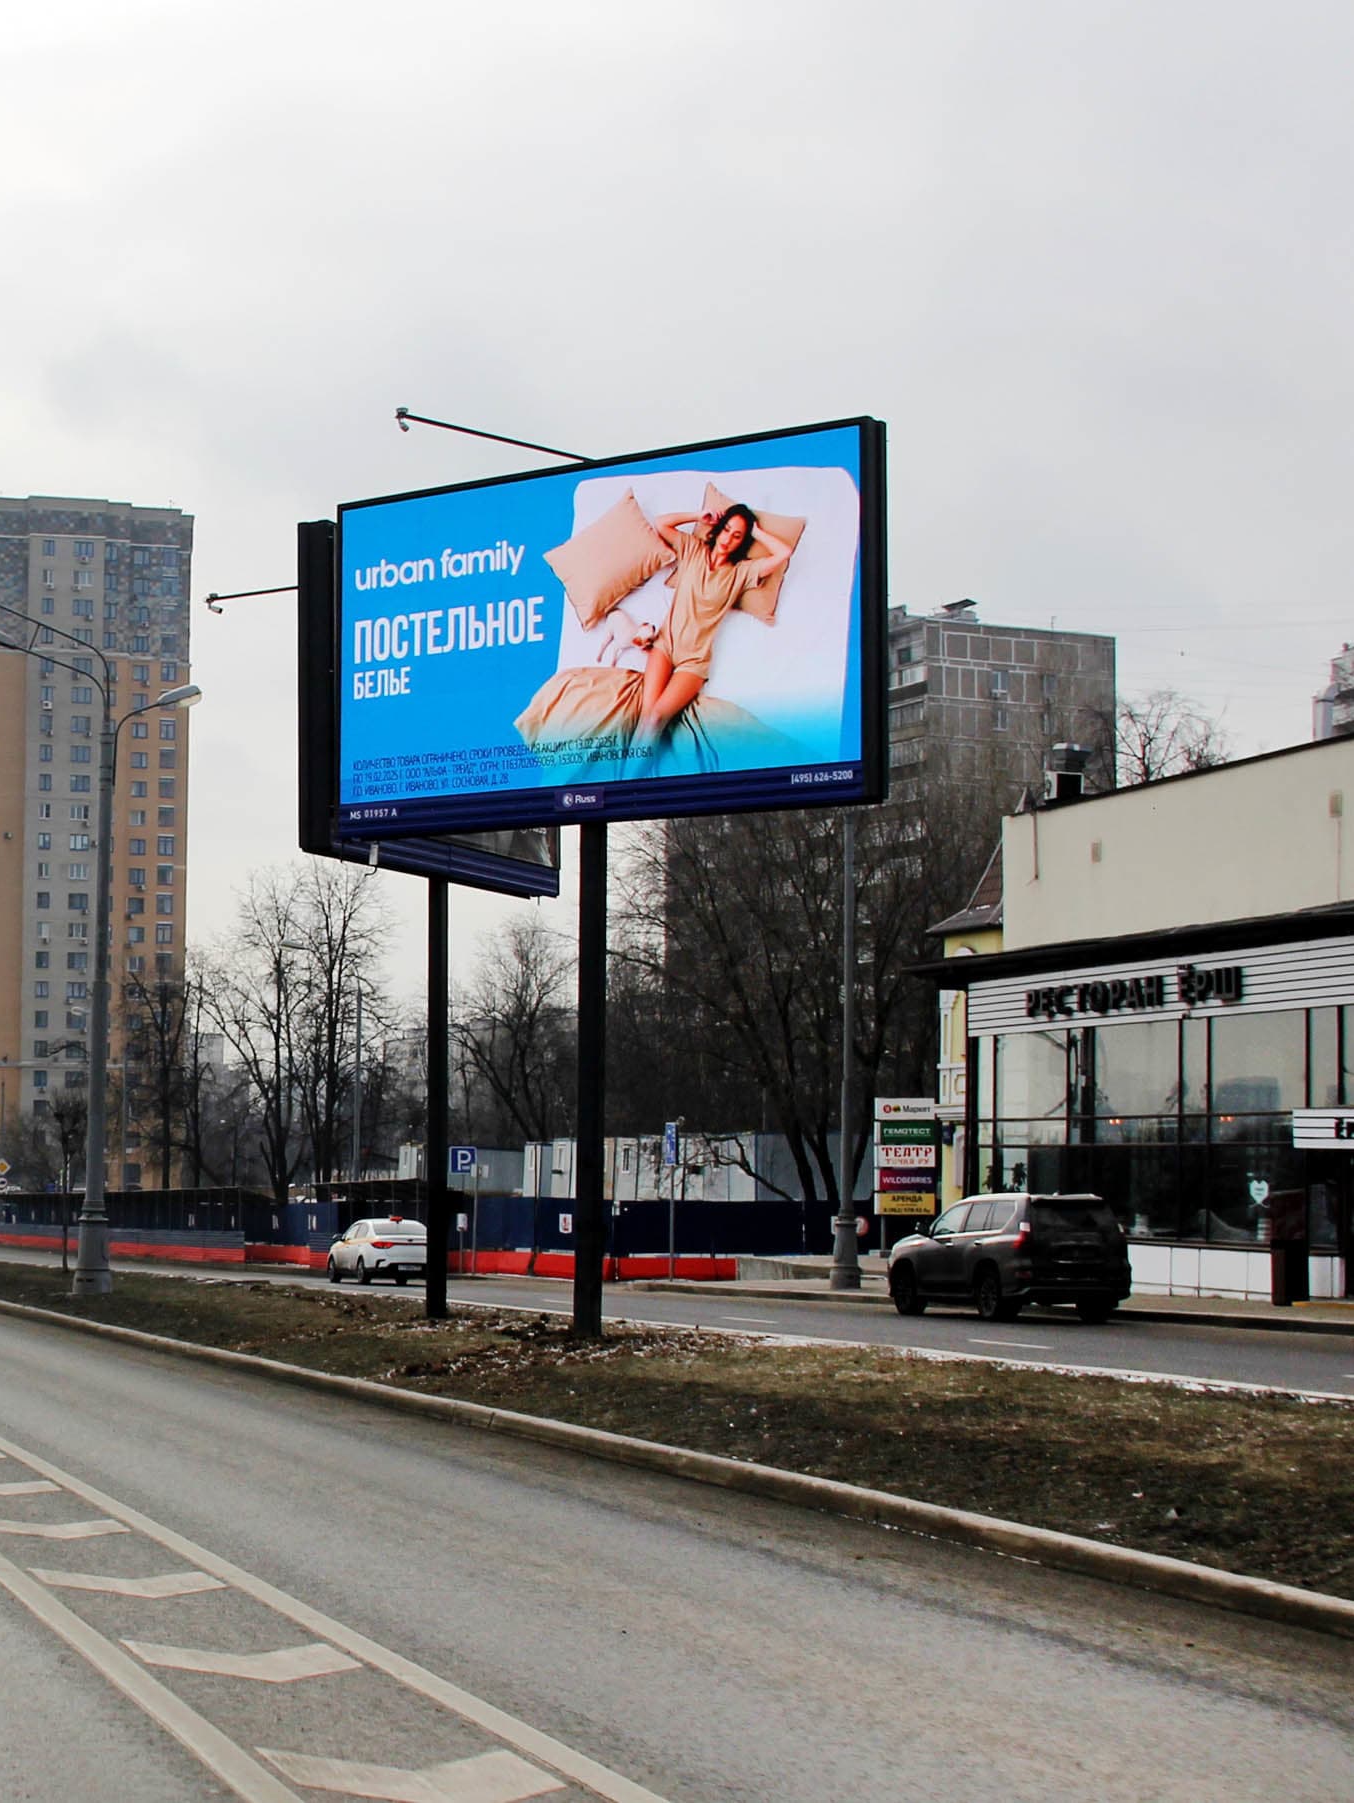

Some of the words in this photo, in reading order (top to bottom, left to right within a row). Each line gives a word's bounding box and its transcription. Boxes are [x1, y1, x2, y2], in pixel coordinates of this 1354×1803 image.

[354, 559, 435, 591] urban
[440, 540, 525, 577] family
[354, 596, 544, 665] ПОСТЕЛЬНОЕ
[353, 666, 411, 700] БЕЛЬЕ
[352, 772, 363, 784] ПО
[405, 767, 421, 779] ООО
[586, 748, 634, 762] ИВАНОВСКАЯ
[353, 758, 396, 770] КОЛИЧЕСТВО
[397, 755, 420, 767] ТОВАРА
[469, 748, 492, 760] СРОКИ
[493, 743, 540, 758] ПРОВЕДЕНИЯ
[541, 741, 566, 753] АКЦИИ
[814, 769, 853, 782] 626-5200
[575, 794, 597, 804] Russ
[349, 810, 362, 820] MS
[364, 808, 389, 818] 01957
[1026, 974, 1164, 1021] РЕСТОРАН
[1177, 963, 1243, 1006] ЁРШ
[883, 1127, 931, 1135] ГЕМОТЕСТ
[881, 1147, 932, 1157] ТЕАТР
[882, 1176, 932, 1185] WILDBERRIES
